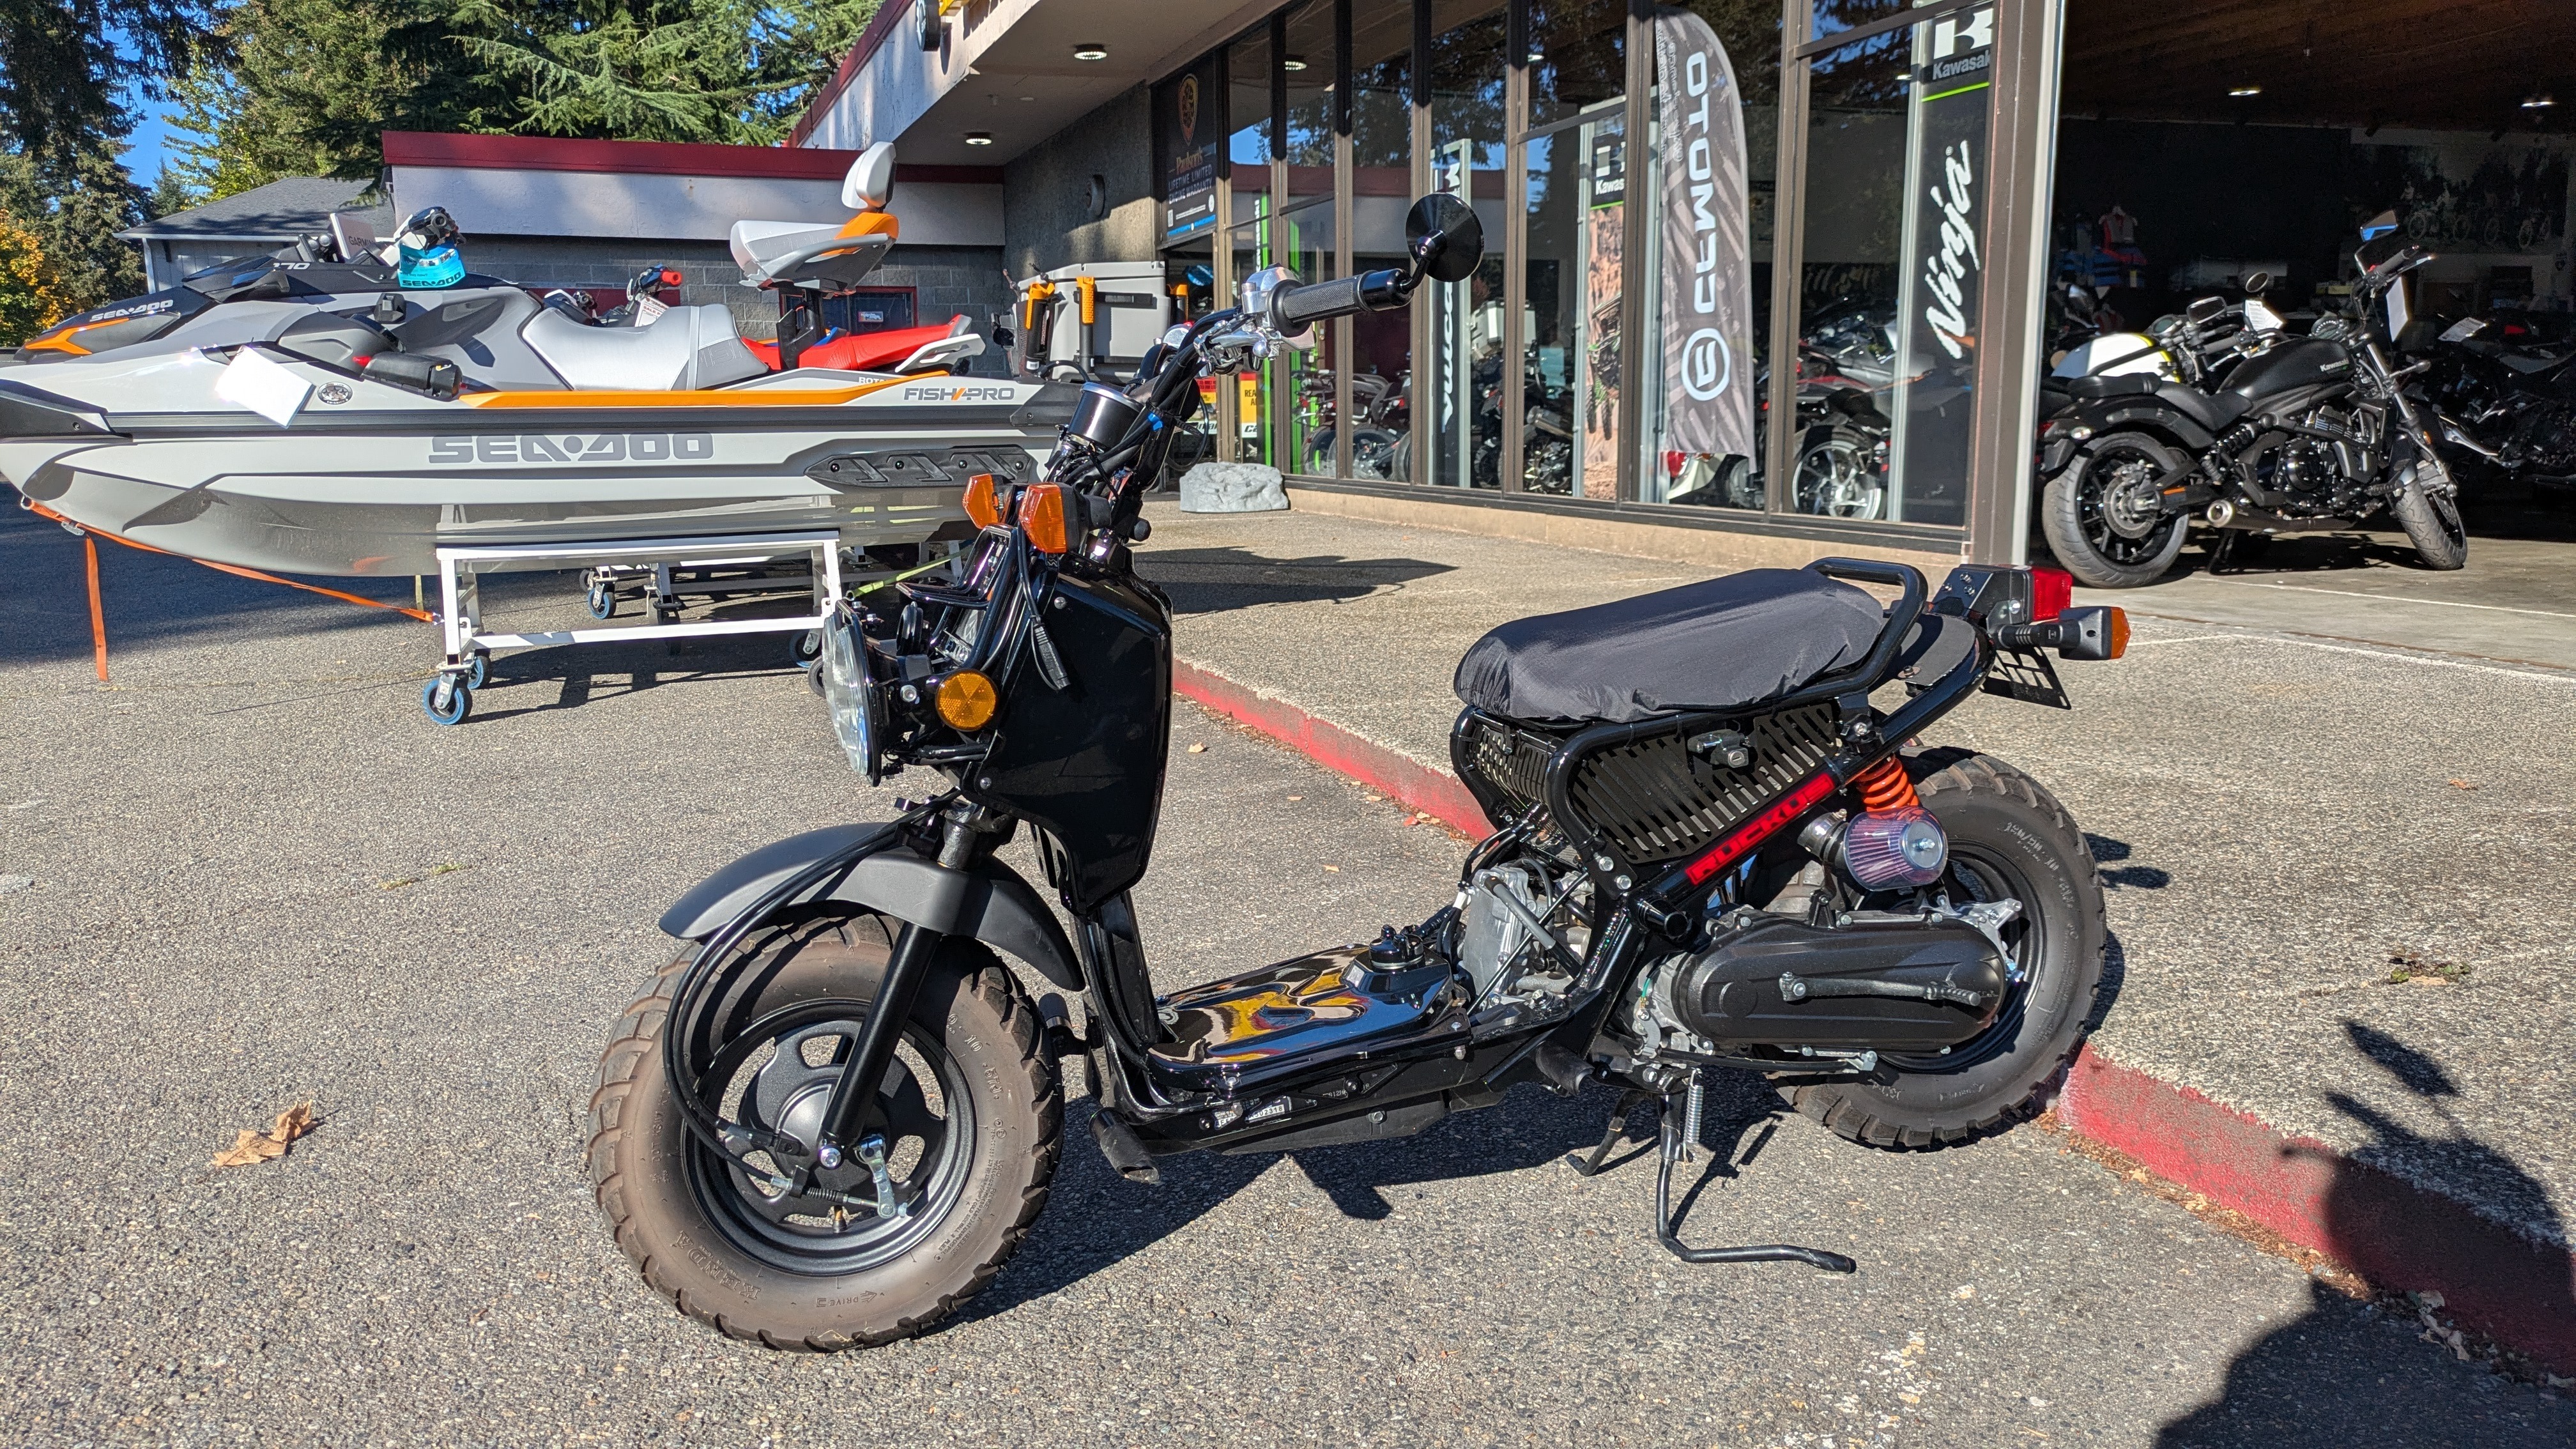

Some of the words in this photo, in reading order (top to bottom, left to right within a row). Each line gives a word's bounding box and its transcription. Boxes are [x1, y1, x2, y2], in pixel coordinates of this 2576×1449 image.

[1932, 49, 1991, 80] Kawasak
[1168, 174, 1190, 192] LIFETIME
[1192, 164, 1213, 182] LIMITED
[1925, 140, 1981, 360] Ninja
[1687, 775, 1833, 883] RUCKUS
[673, 1230, 762, 1302] KENDA
[829, 1296, 860, 1307] DRIVE
